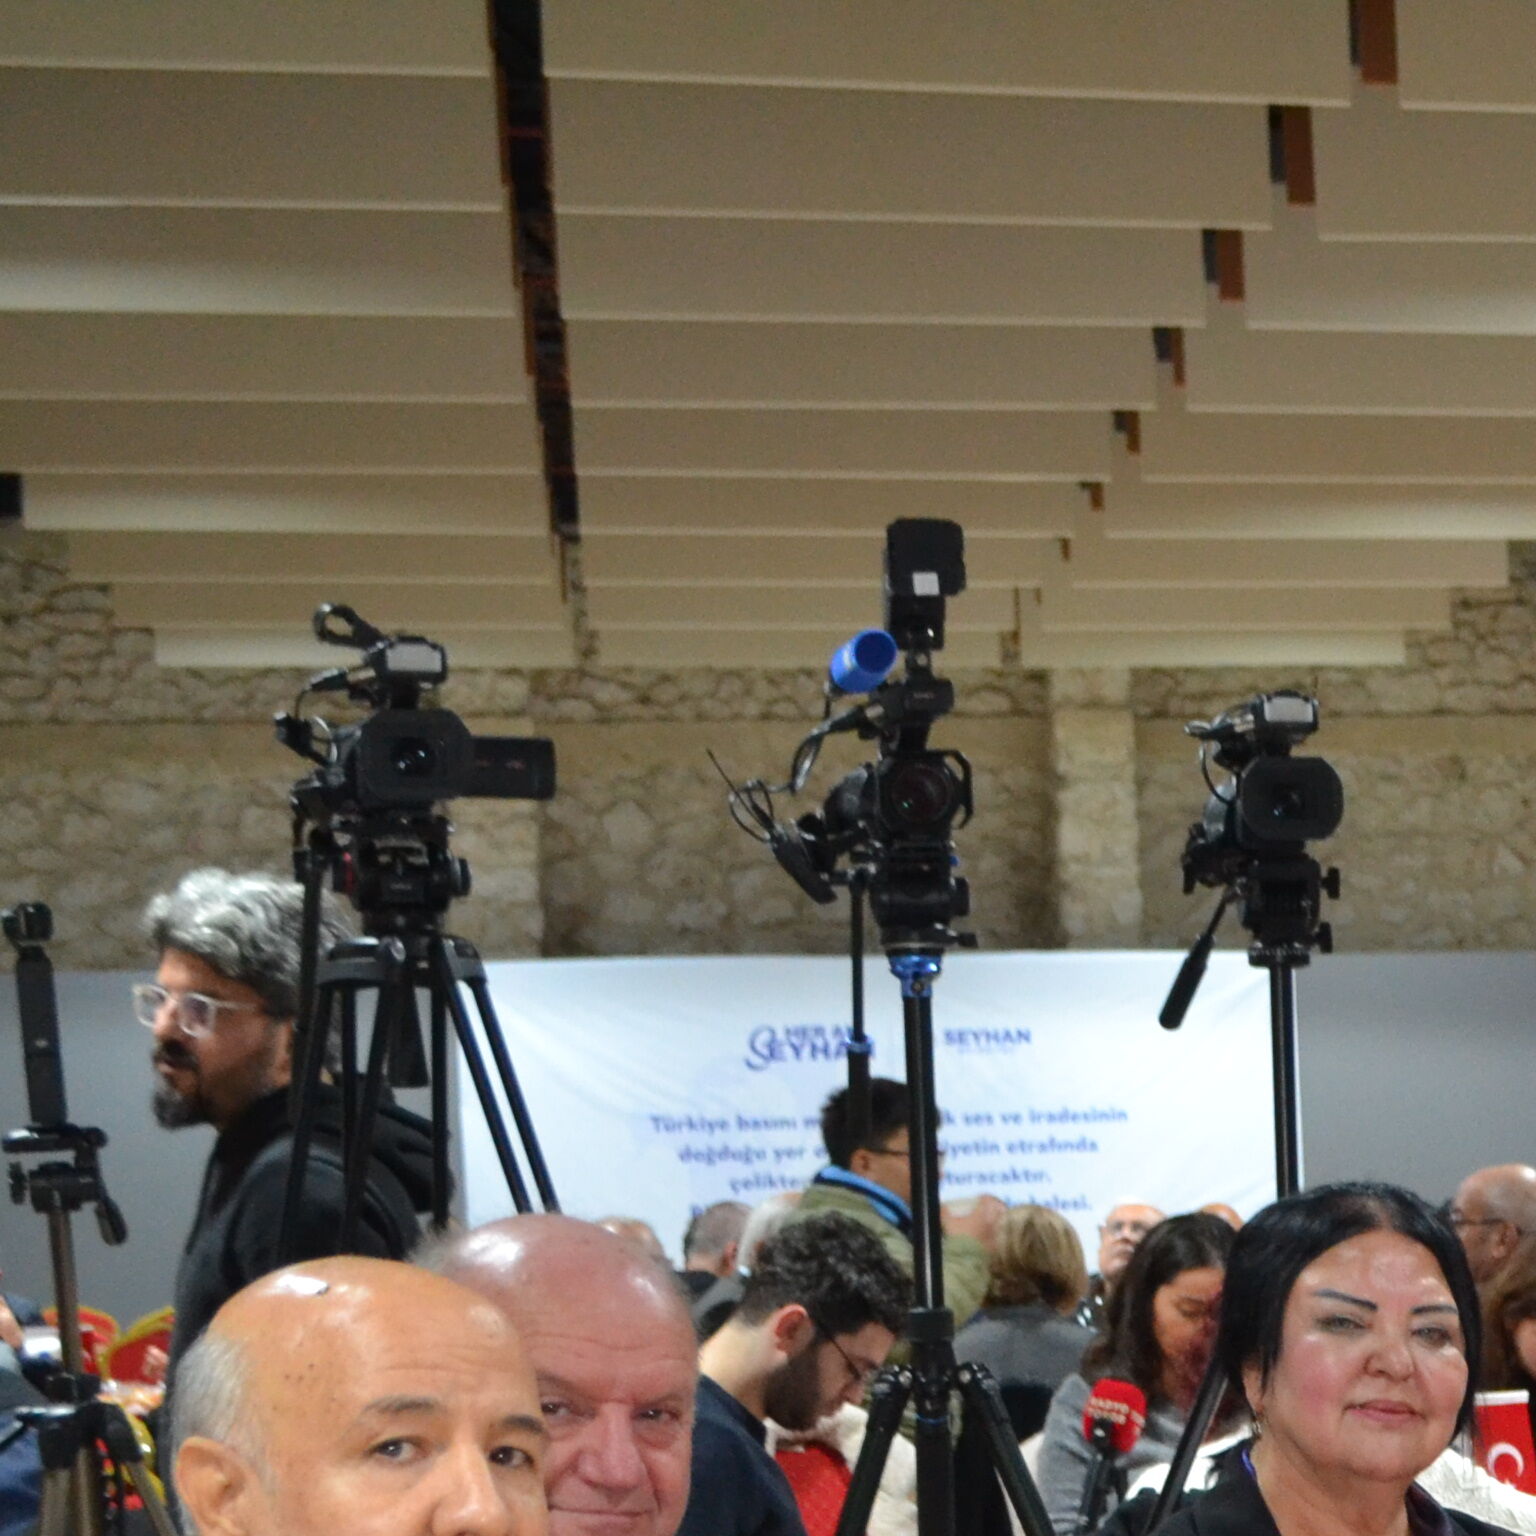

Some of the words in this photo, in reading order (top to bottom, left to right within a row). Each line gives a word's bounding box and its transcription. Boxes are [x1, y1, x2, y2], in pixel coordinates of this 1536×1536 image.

[944, 1027, 1031, 1044] SEYHAN
[1002, 1112, 1022, 1124] ve
[1029, 1107, 1128, 1124] iradesinin
[650, 1114, 730, 1135] Türkiye
[737, 1114, 797, 1130] basını
